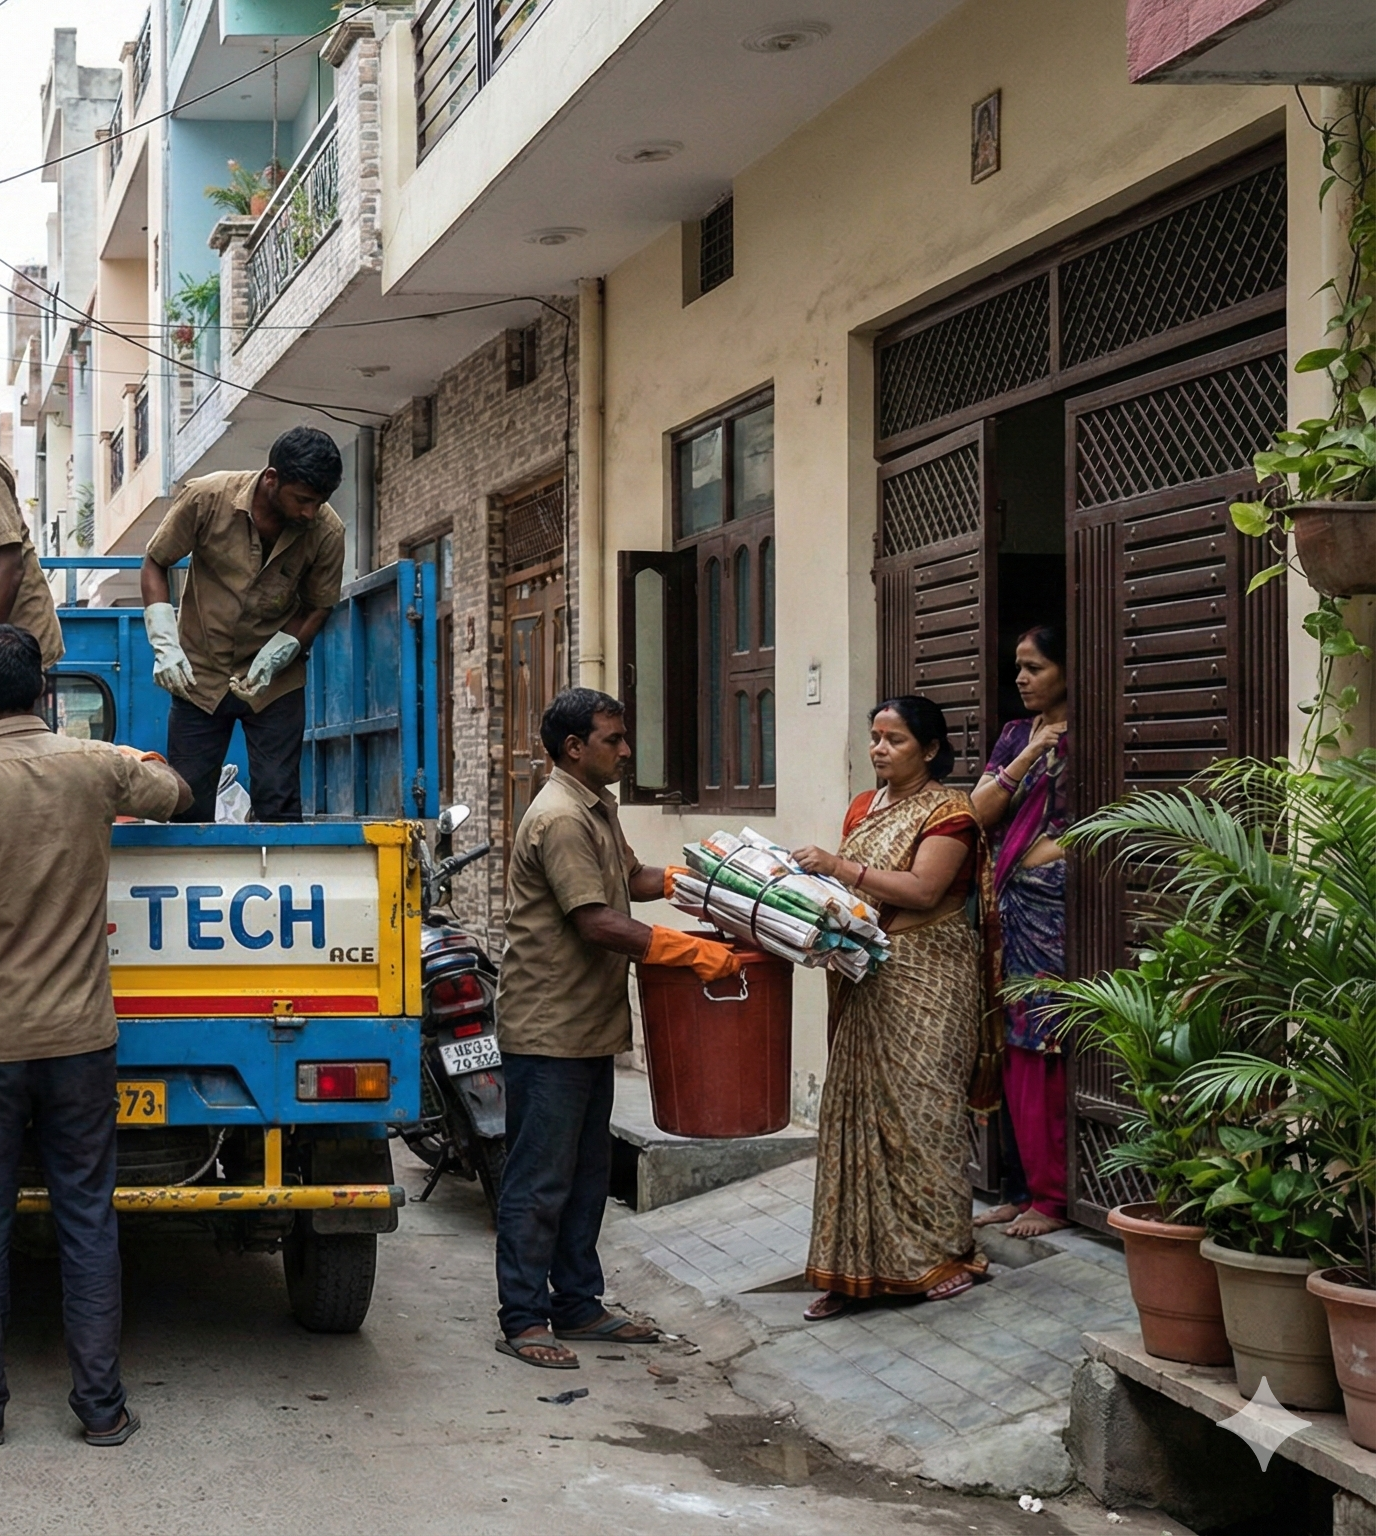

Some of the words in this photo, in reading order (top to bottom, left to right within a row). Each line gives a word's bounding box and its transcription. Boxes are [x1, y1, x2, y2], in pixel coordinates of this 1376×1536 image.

[130, 884, 326, 951] TECH
[329, 947, 374, 963] ACE
[118, 1089, 156, 1117] 73
